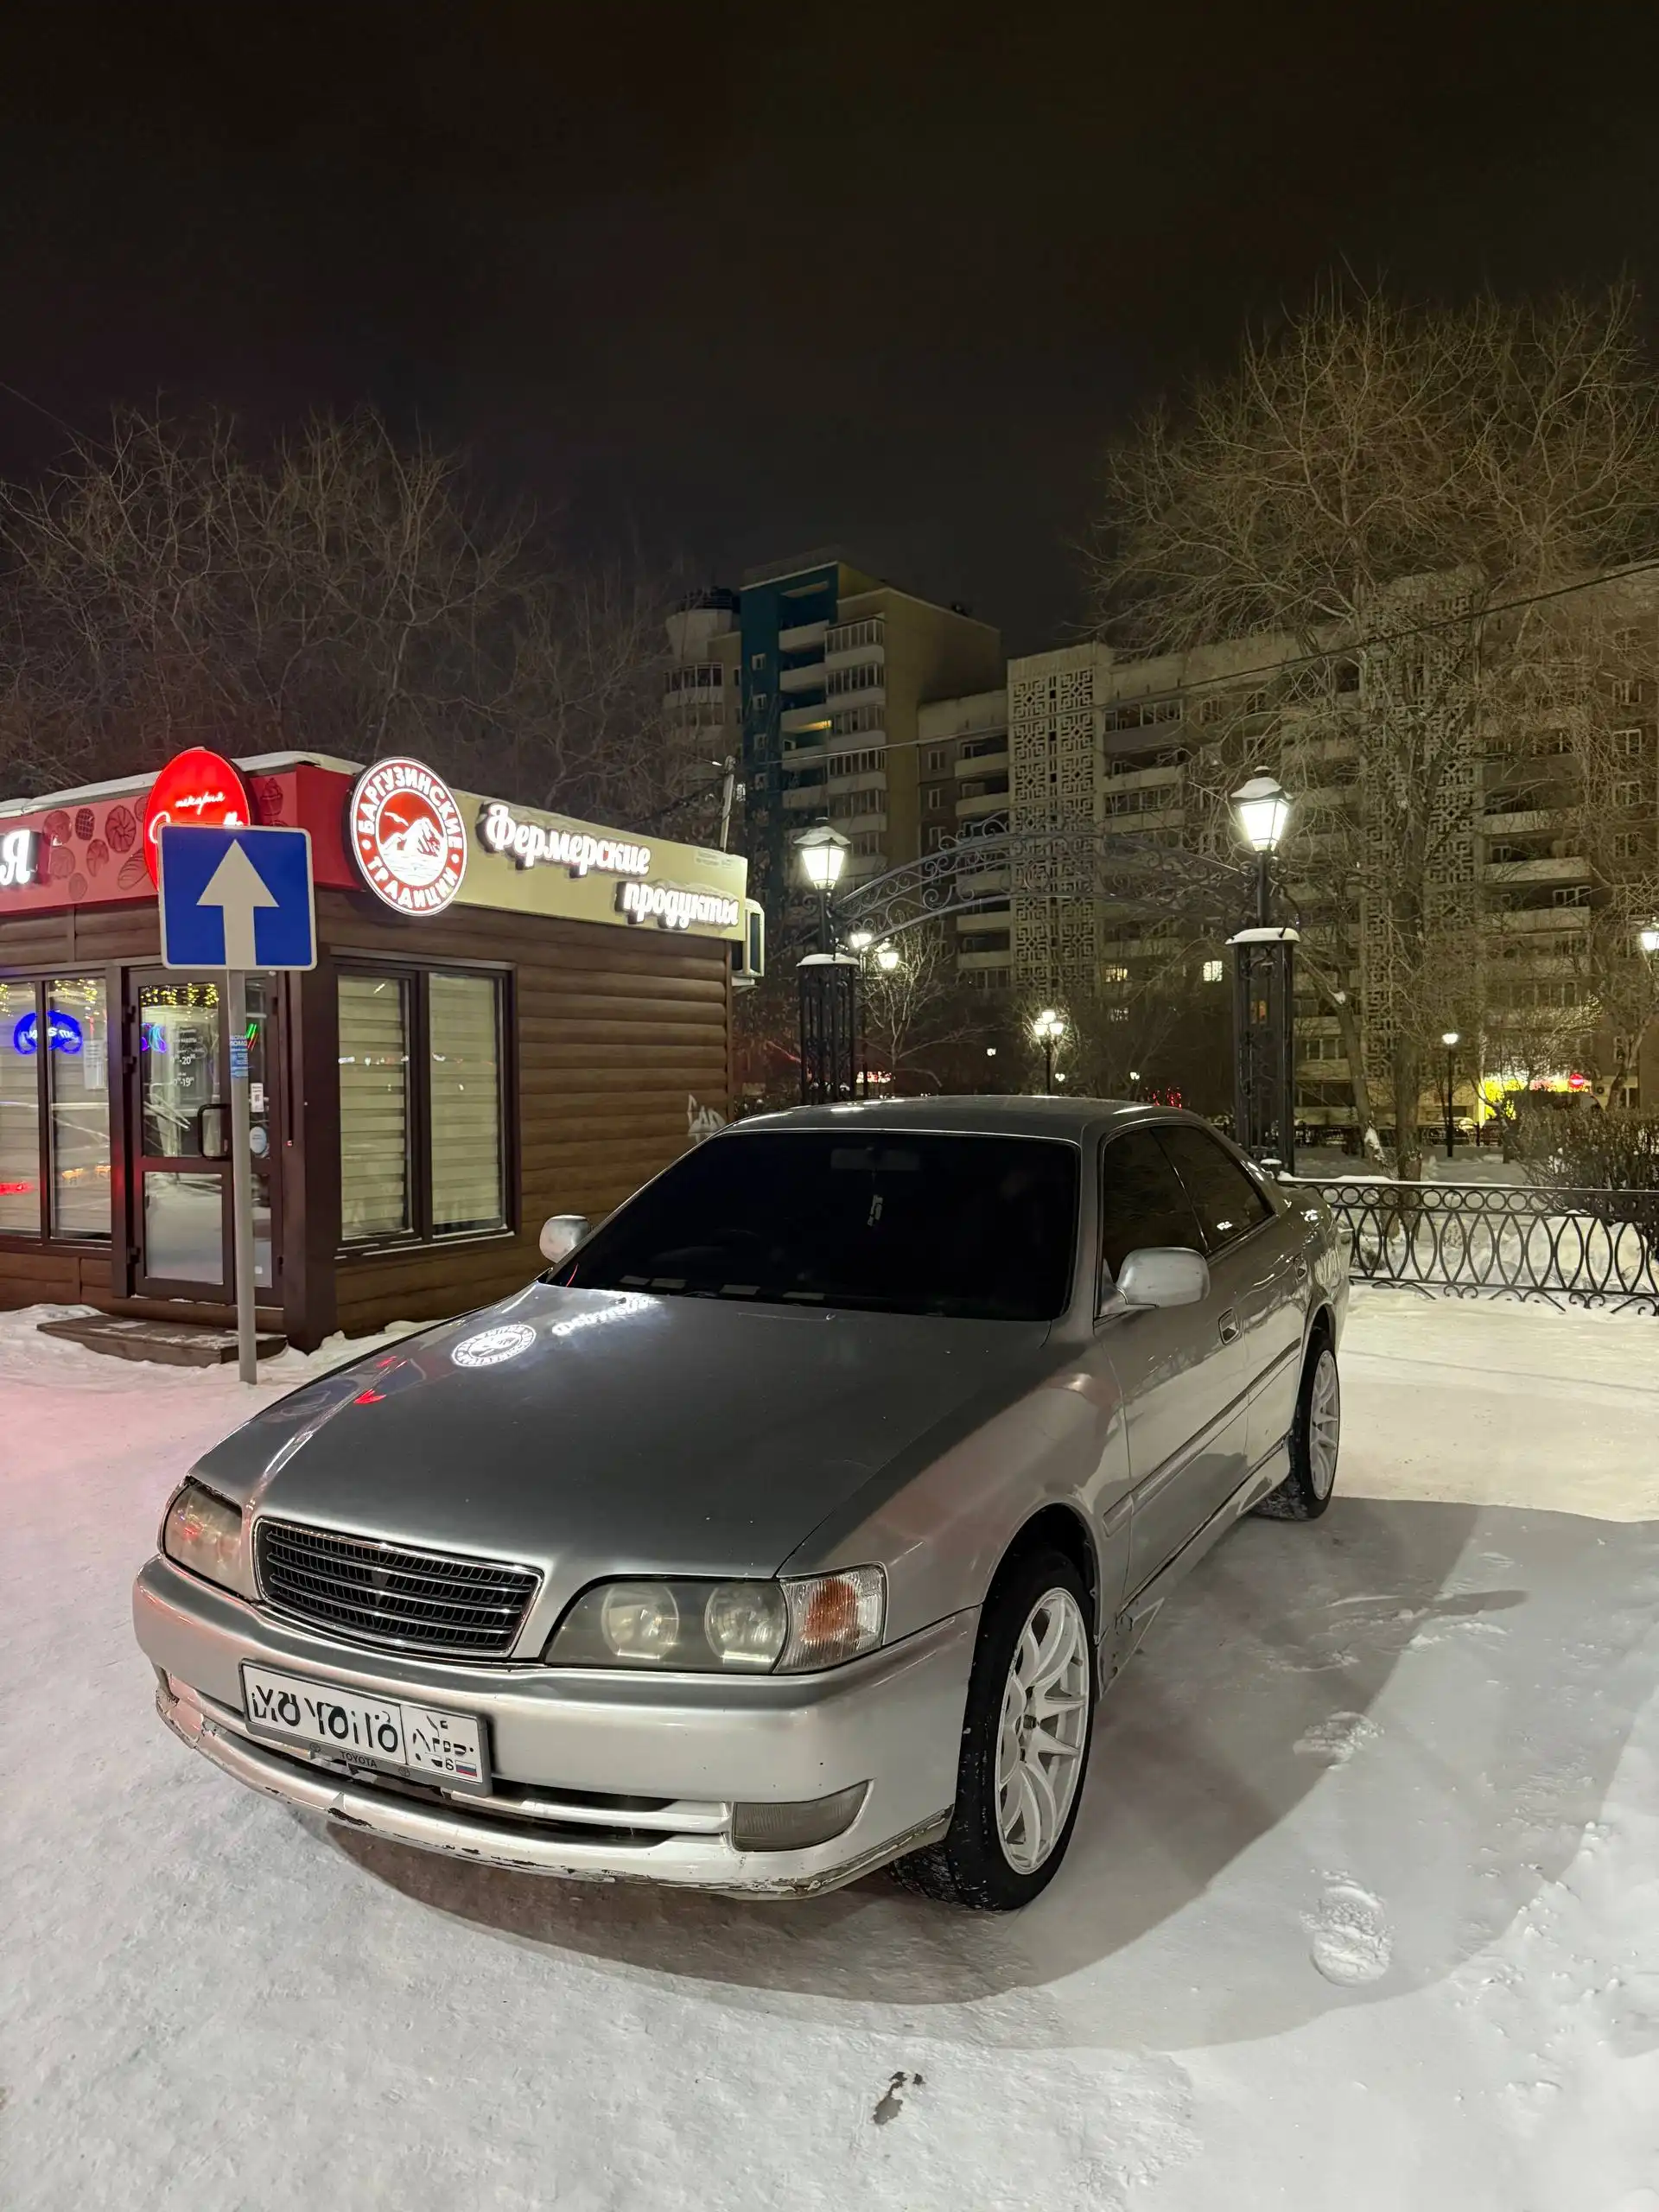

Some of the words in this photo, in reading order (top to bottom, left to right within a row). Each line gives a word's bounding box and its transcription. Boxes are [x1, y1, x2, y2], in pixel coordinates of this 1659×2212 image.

[358, 766, 463, 849] БАРГУЗИНСКИЕ
[486, 804, 652, 877] Фермерские
[367, 855, 459, 909] ТРАДИЦИИ
[624, 881, 740, 929] продукты
[340, 1751, 378, 1768] TOYOTA
